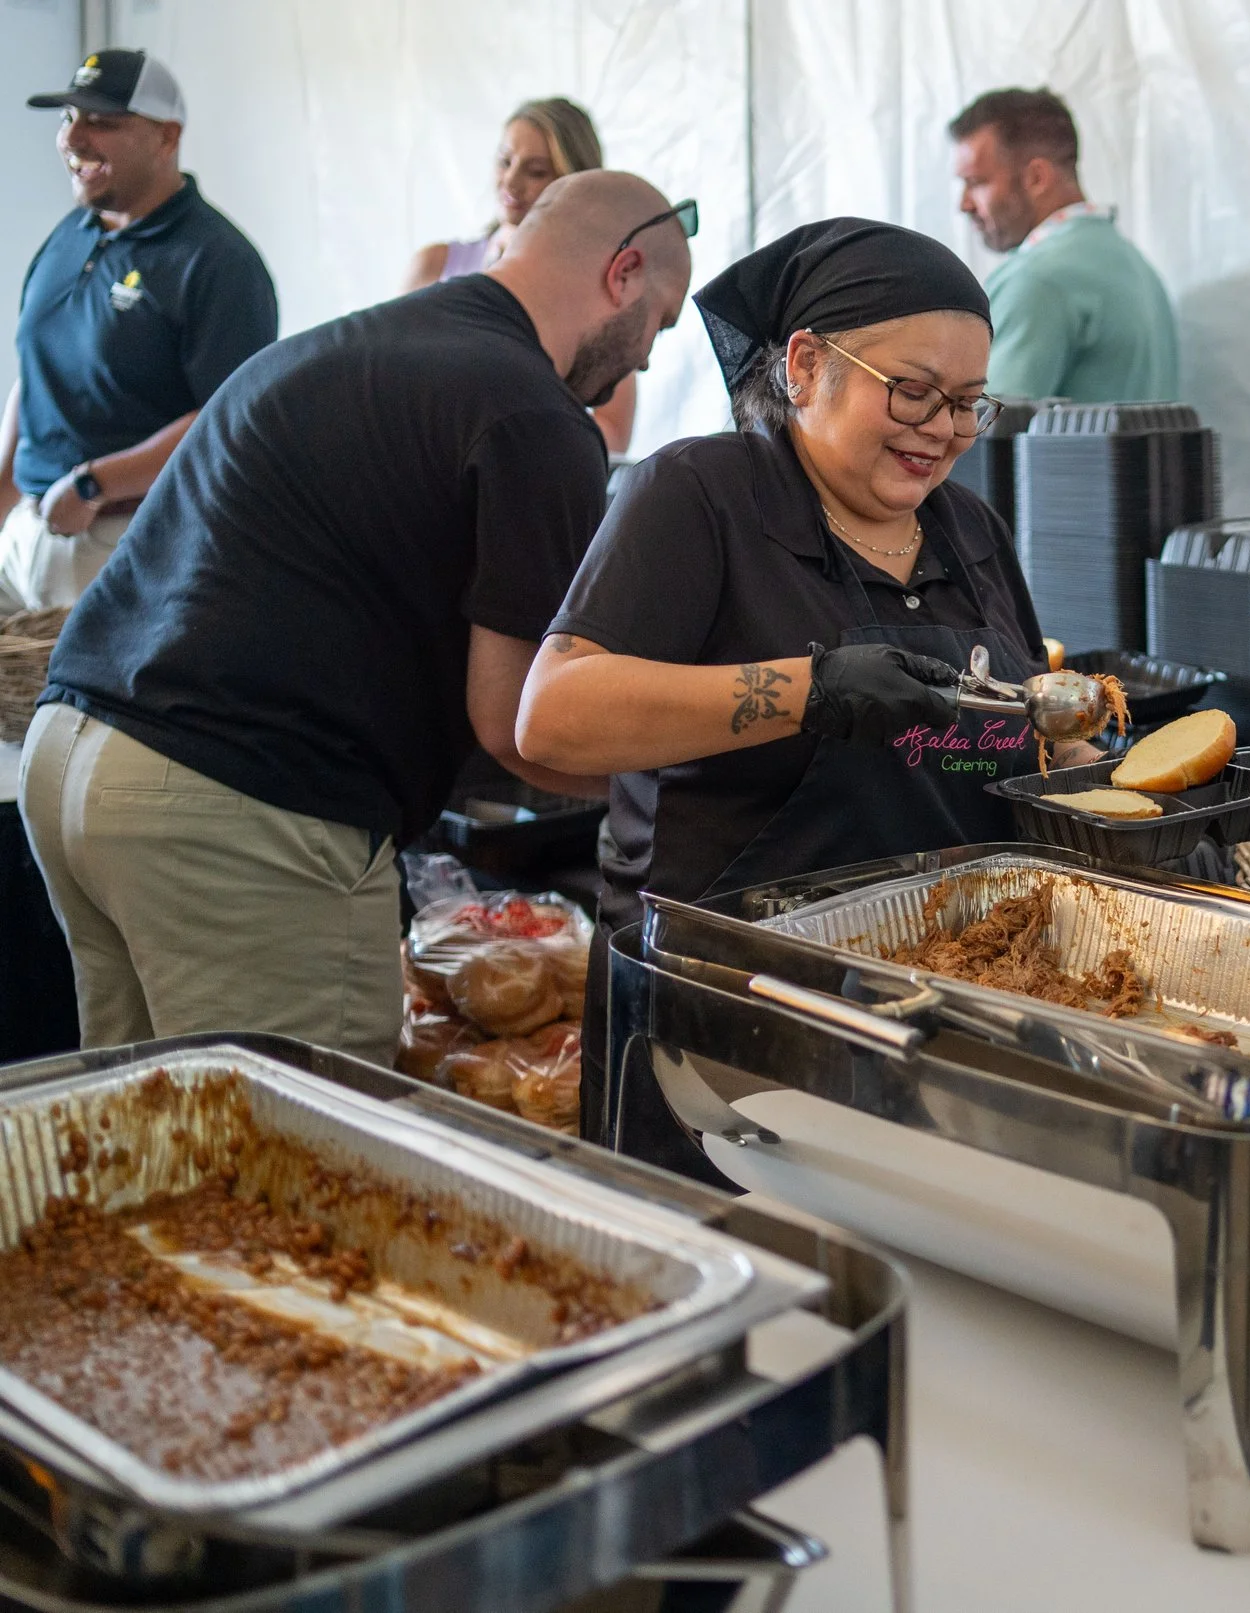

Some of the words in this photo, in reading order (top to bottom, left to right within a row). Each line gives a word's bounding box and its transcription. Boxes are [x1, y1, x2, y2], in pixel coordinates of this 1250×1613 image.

[893, 722, 971, 767] Azalea
[977, 719, 1030, 750] Creek
[941, 755, 998, 777] Catering
